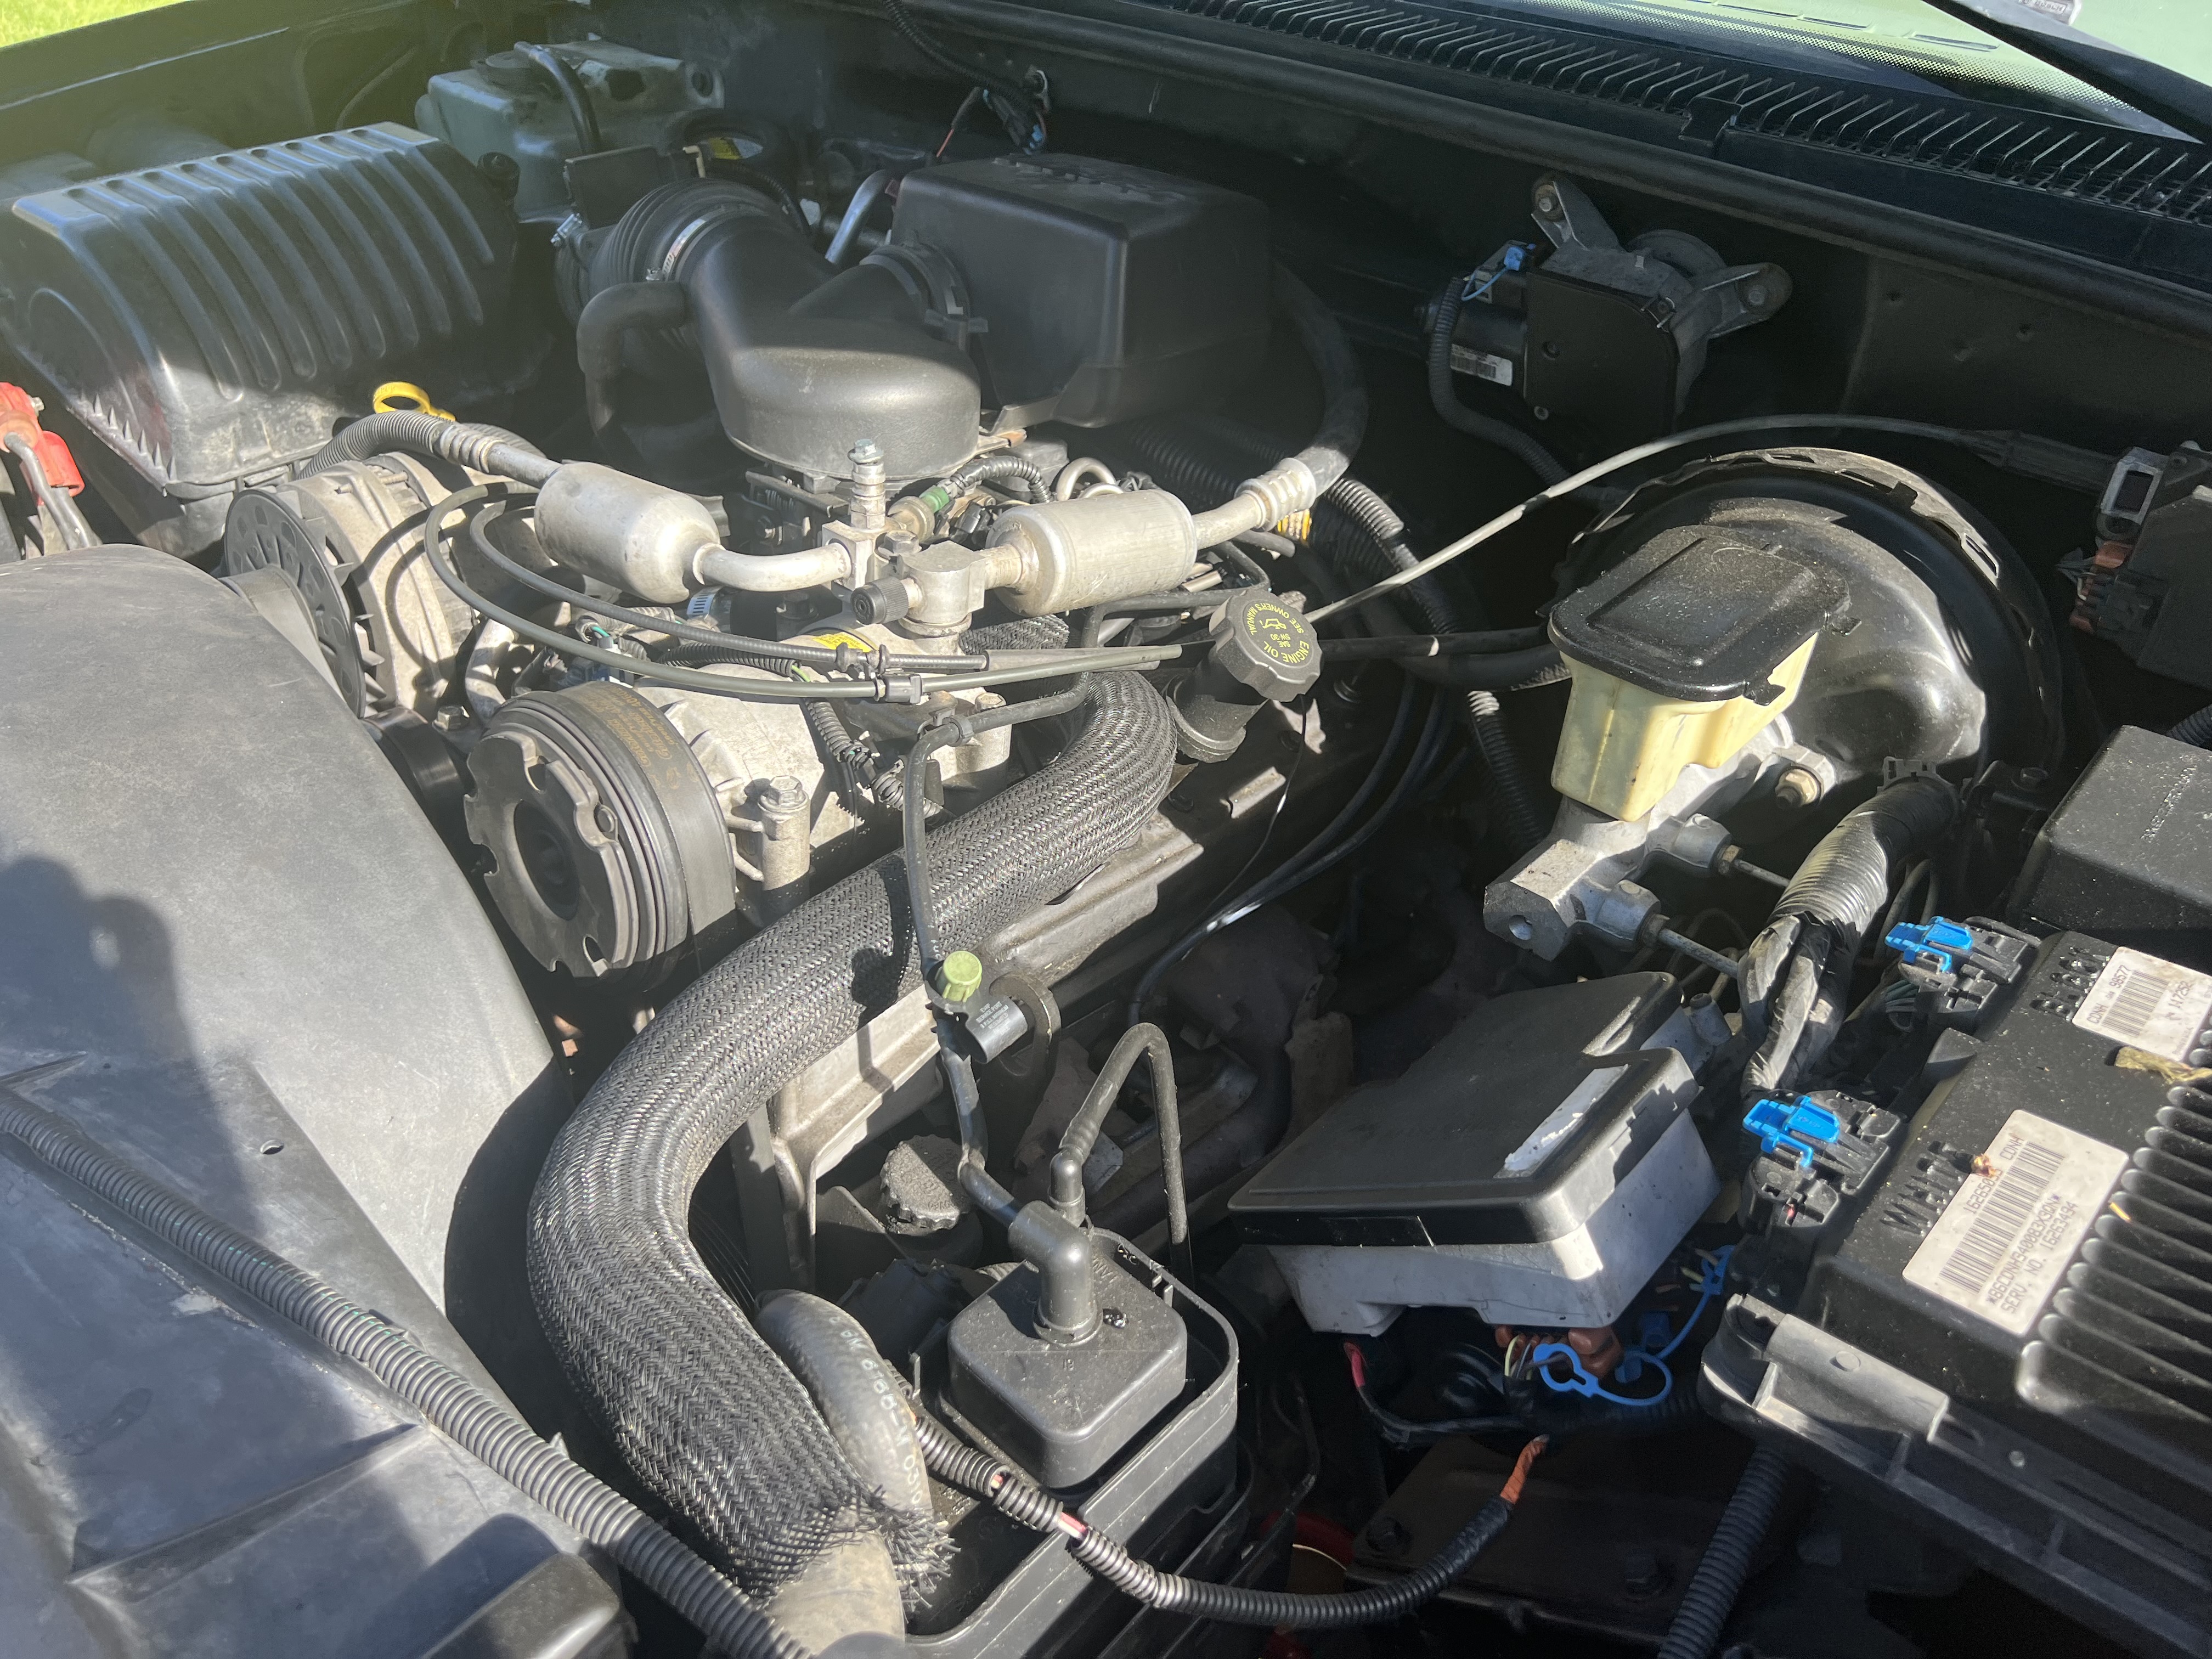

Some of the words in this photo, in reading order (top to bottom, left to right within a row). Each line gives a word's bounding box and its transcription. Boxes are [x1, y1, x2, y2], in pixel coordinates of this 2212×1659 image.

[1246, 607, 1258, 635] MANUAL
[1255, 603, 1290, 619] OWNER'S
[1289, 618, 1304, 634] SEE
[1264, 641, 1279, 658] OIL
[1281, 640, 1310, 663] ENGINE
[2087, 1003, 2107, 1024] CDNH
[2109, 964, 2130, 989] 98577
[990, 1001, 1002, 1011] PORT
[2000, 1135, 2023, 1160] CDNH
[2041, 1201, 2078, 1250] 16263494
[839, 1327, 867, 1351] GM
